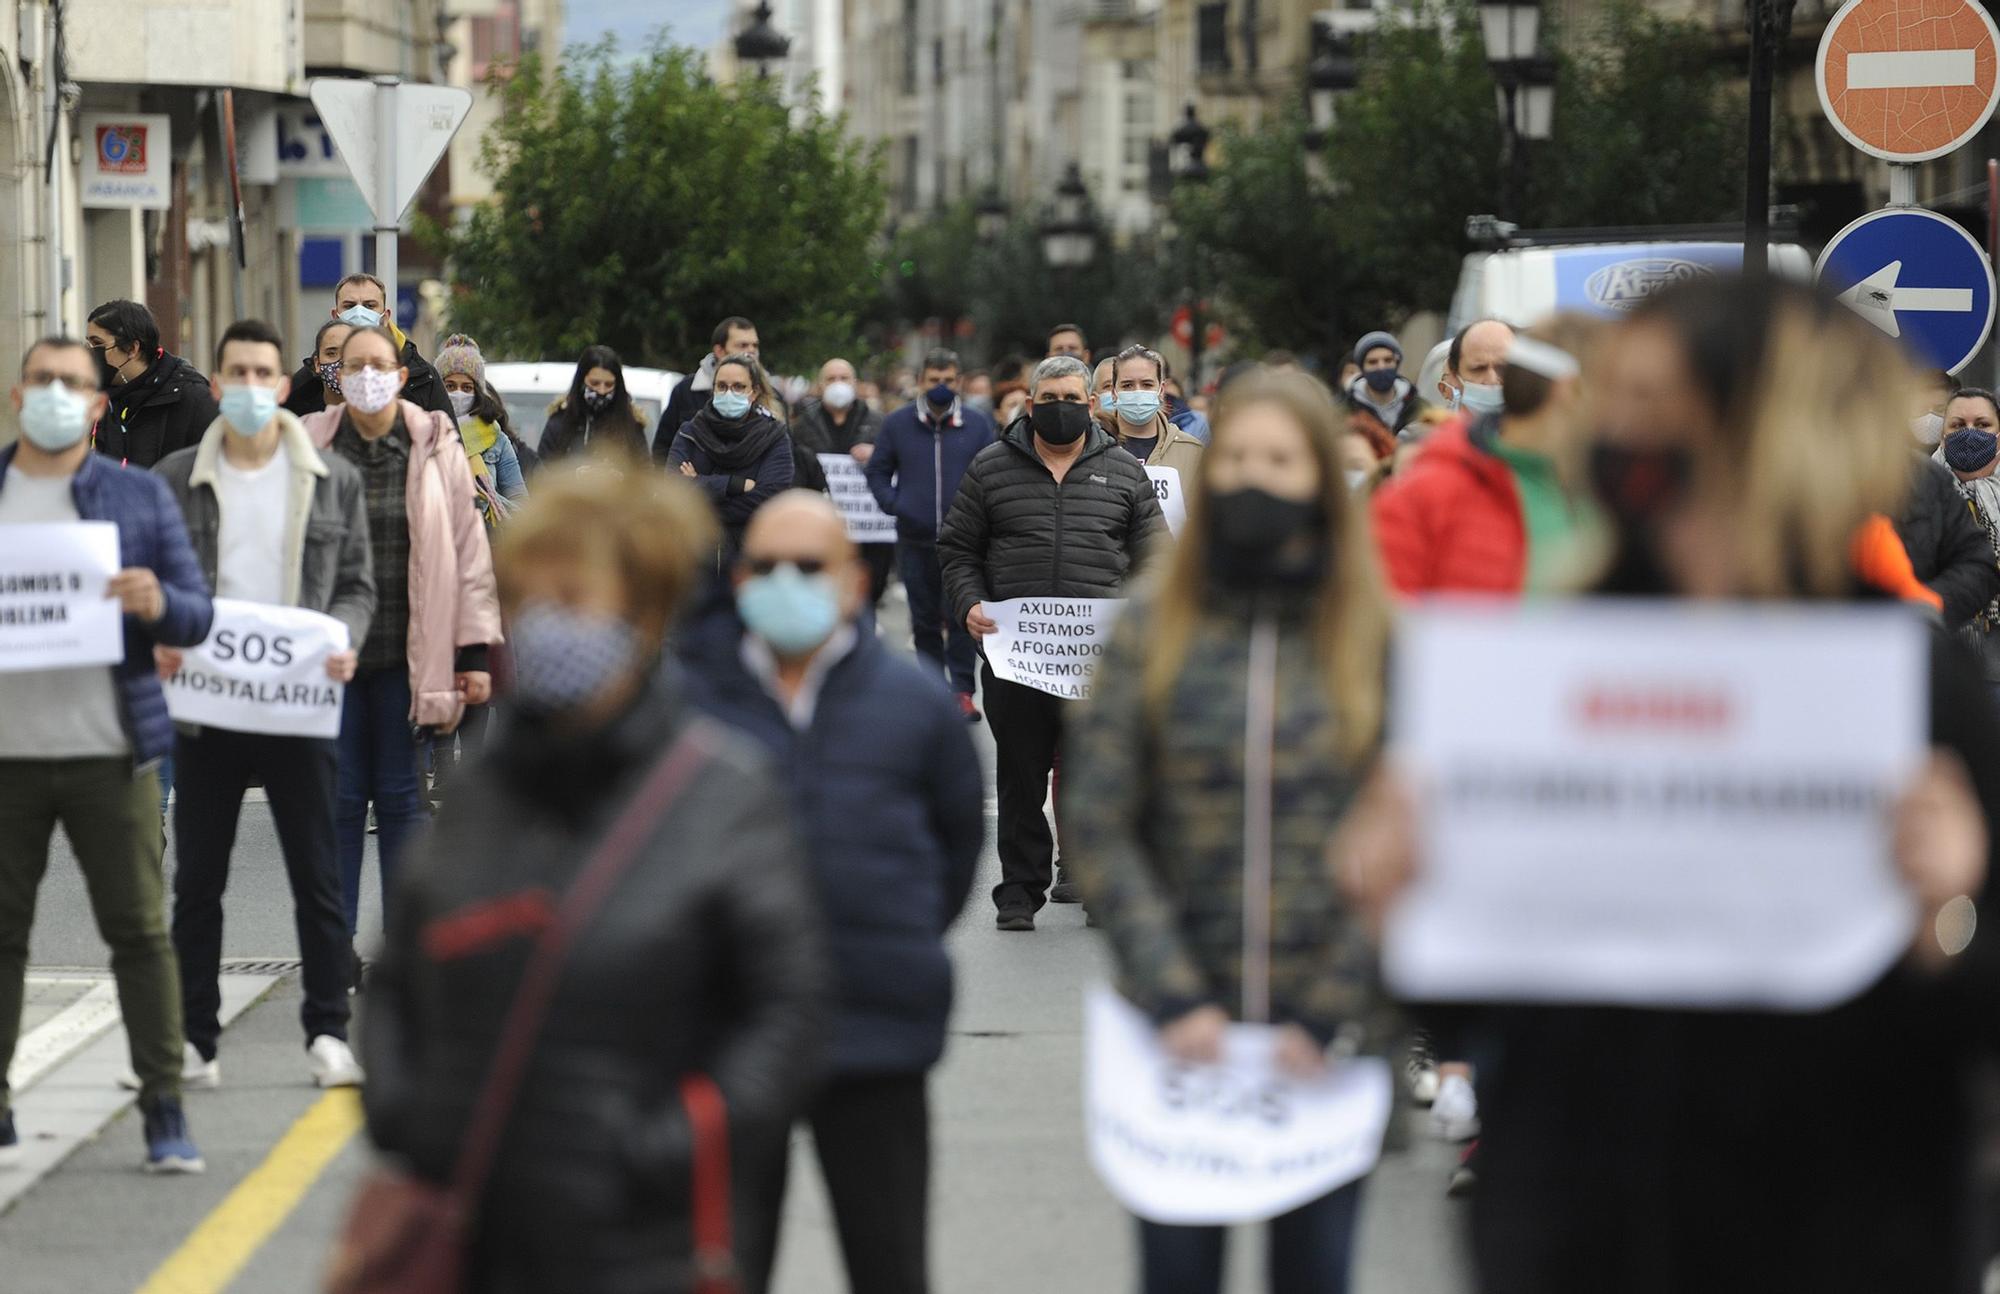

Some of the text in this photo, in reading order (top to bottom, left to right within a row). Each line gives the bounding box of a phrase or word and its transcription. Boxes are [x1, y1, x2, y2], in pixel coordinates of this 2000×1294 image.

[0, 604, 67, 627] BLEMA
[1019, 602, 1093, 617] AXUDA!!!
[1018, 621, 1096, 637] ESTAMOS
[213, 629, 294, 667] SOS
[1010, 640, 1103, 657] AFOGANDO
[1007, 658, 1095, 677] SALVEMOS
[170, 669, 338, 707] HOSTALARIA
